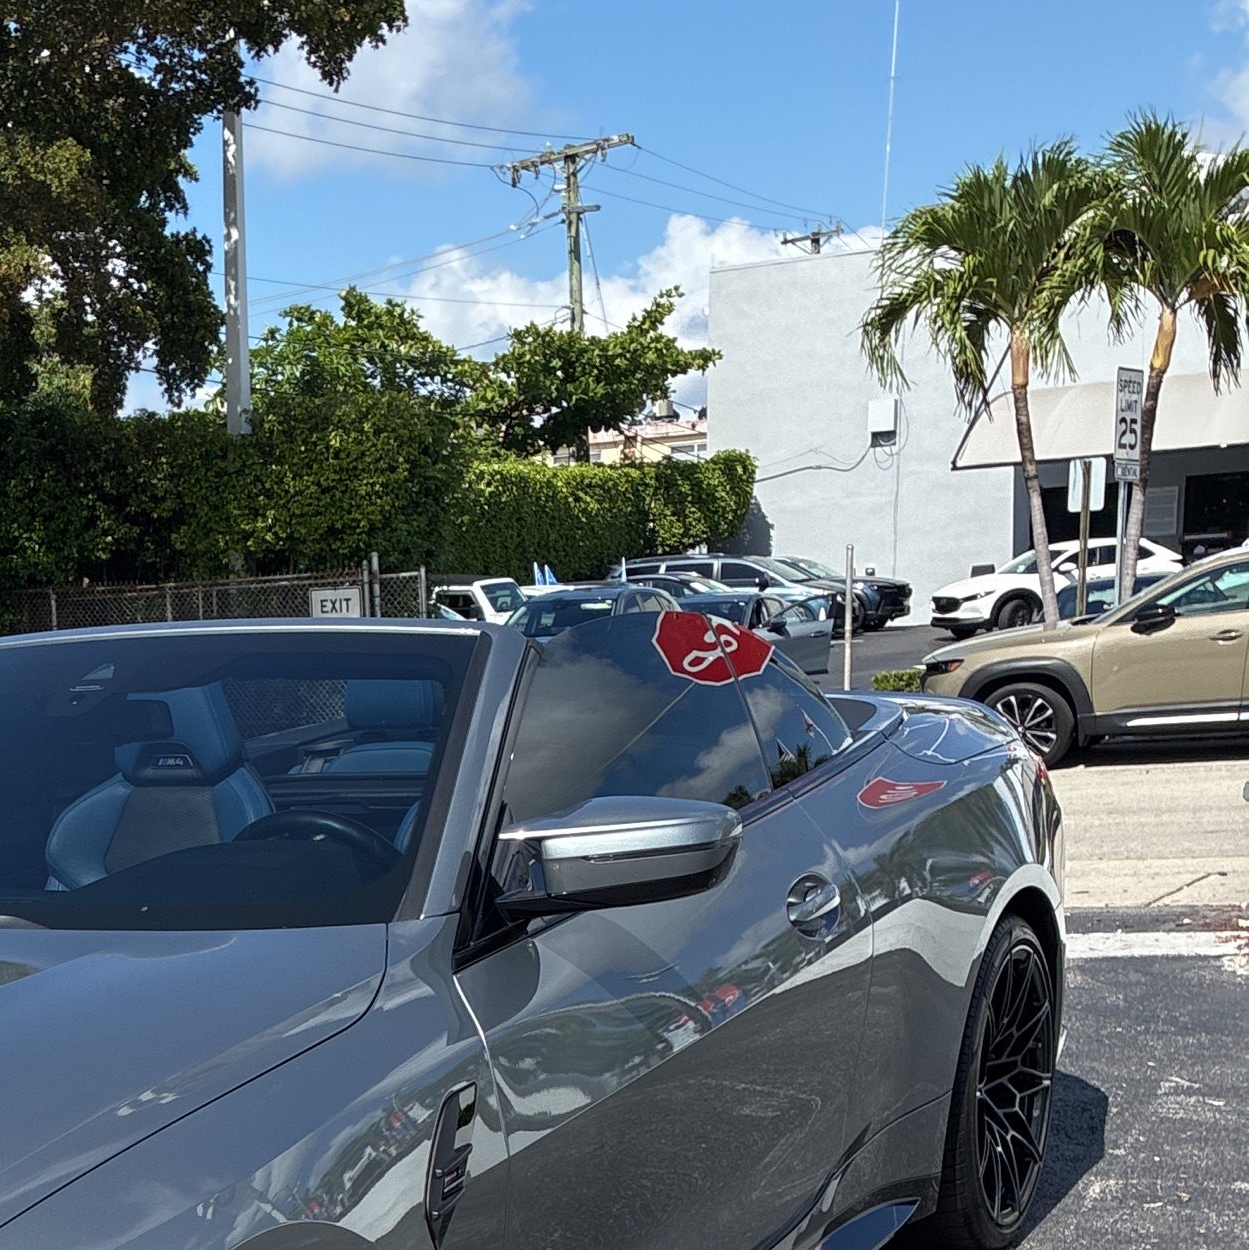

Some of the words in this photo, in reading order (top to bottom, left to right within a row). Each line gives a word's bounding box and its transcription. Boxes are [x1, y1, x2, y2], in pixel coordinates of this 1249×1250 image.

[1118, 379, 1141, 395] SPEED
[1120, 400, 1139, 414] LIMIT
[1118, 416, 1138, 450] 25
[320, 597, 352, 614] EXIT
